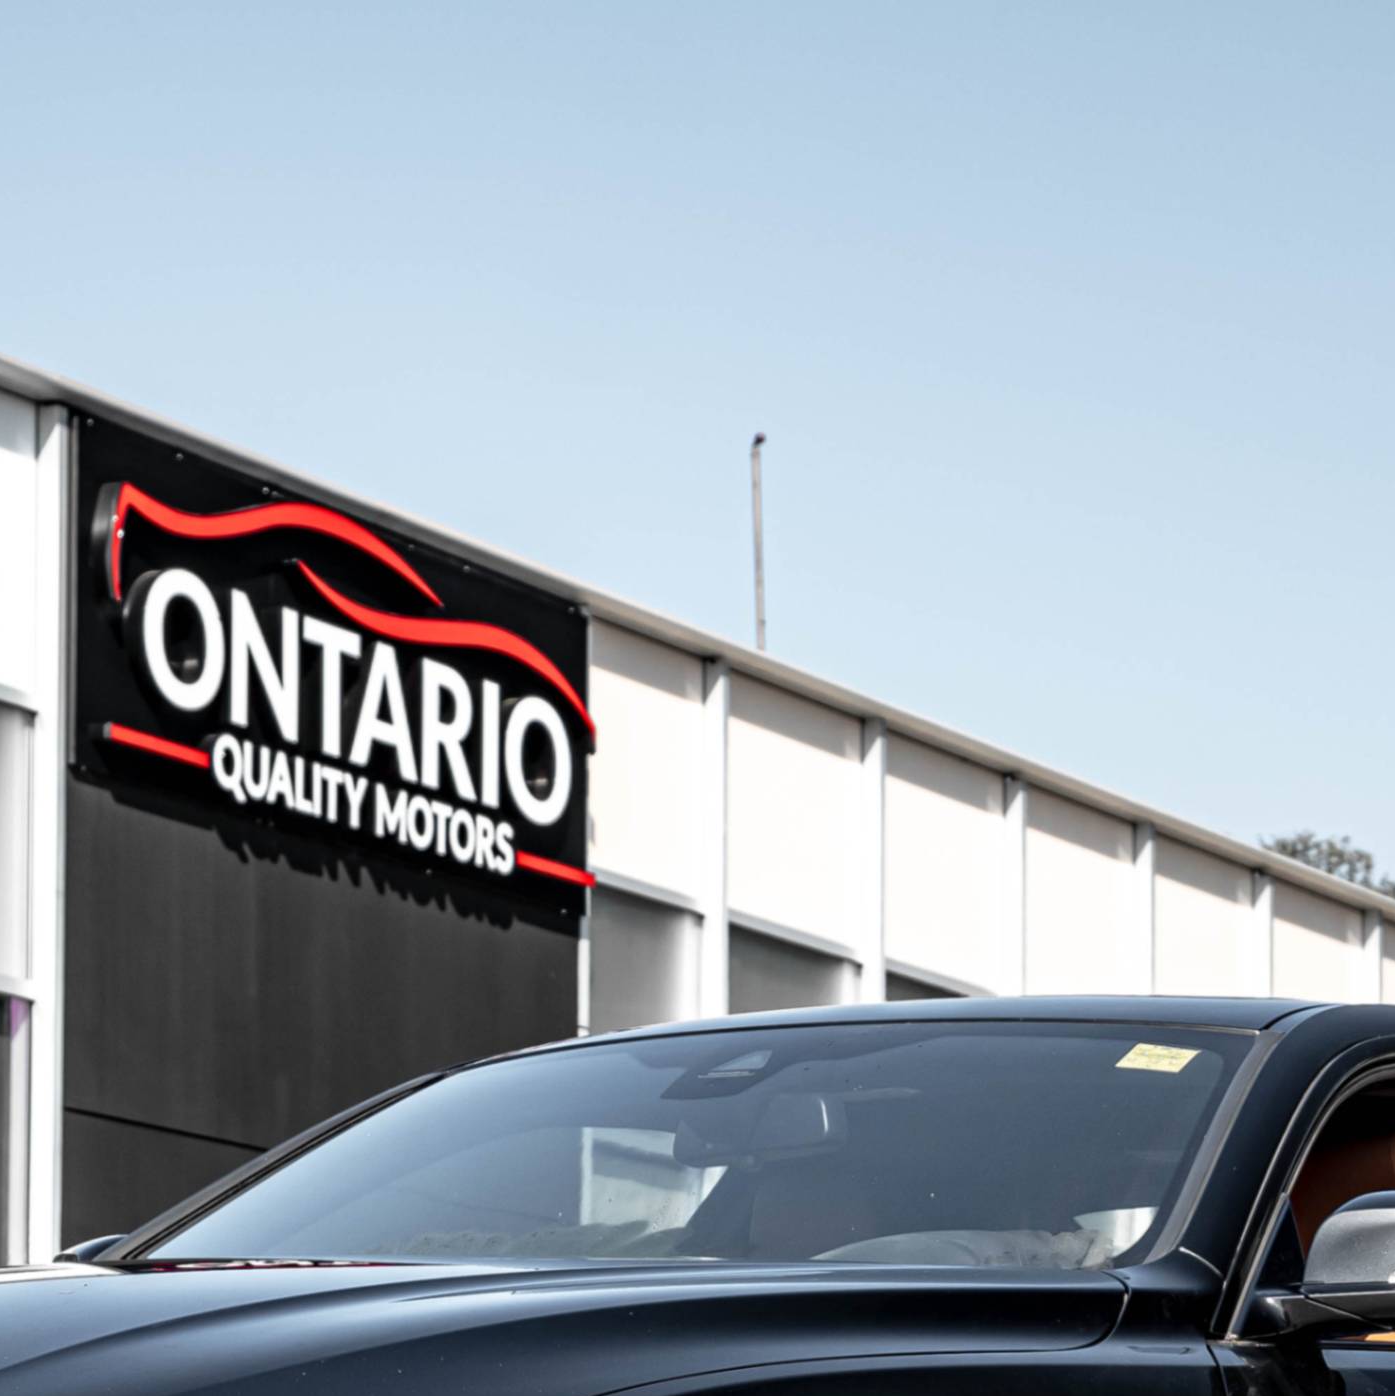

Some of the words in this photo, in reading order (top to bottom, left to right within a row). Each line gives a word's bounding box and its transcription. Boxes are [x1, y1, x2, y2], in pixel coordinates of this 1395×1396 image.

[142, 567, 573, 826] ONTARIO
[211, 733, 368, 830] QUALITY
[375, 782, 515, 875] MOTORS
